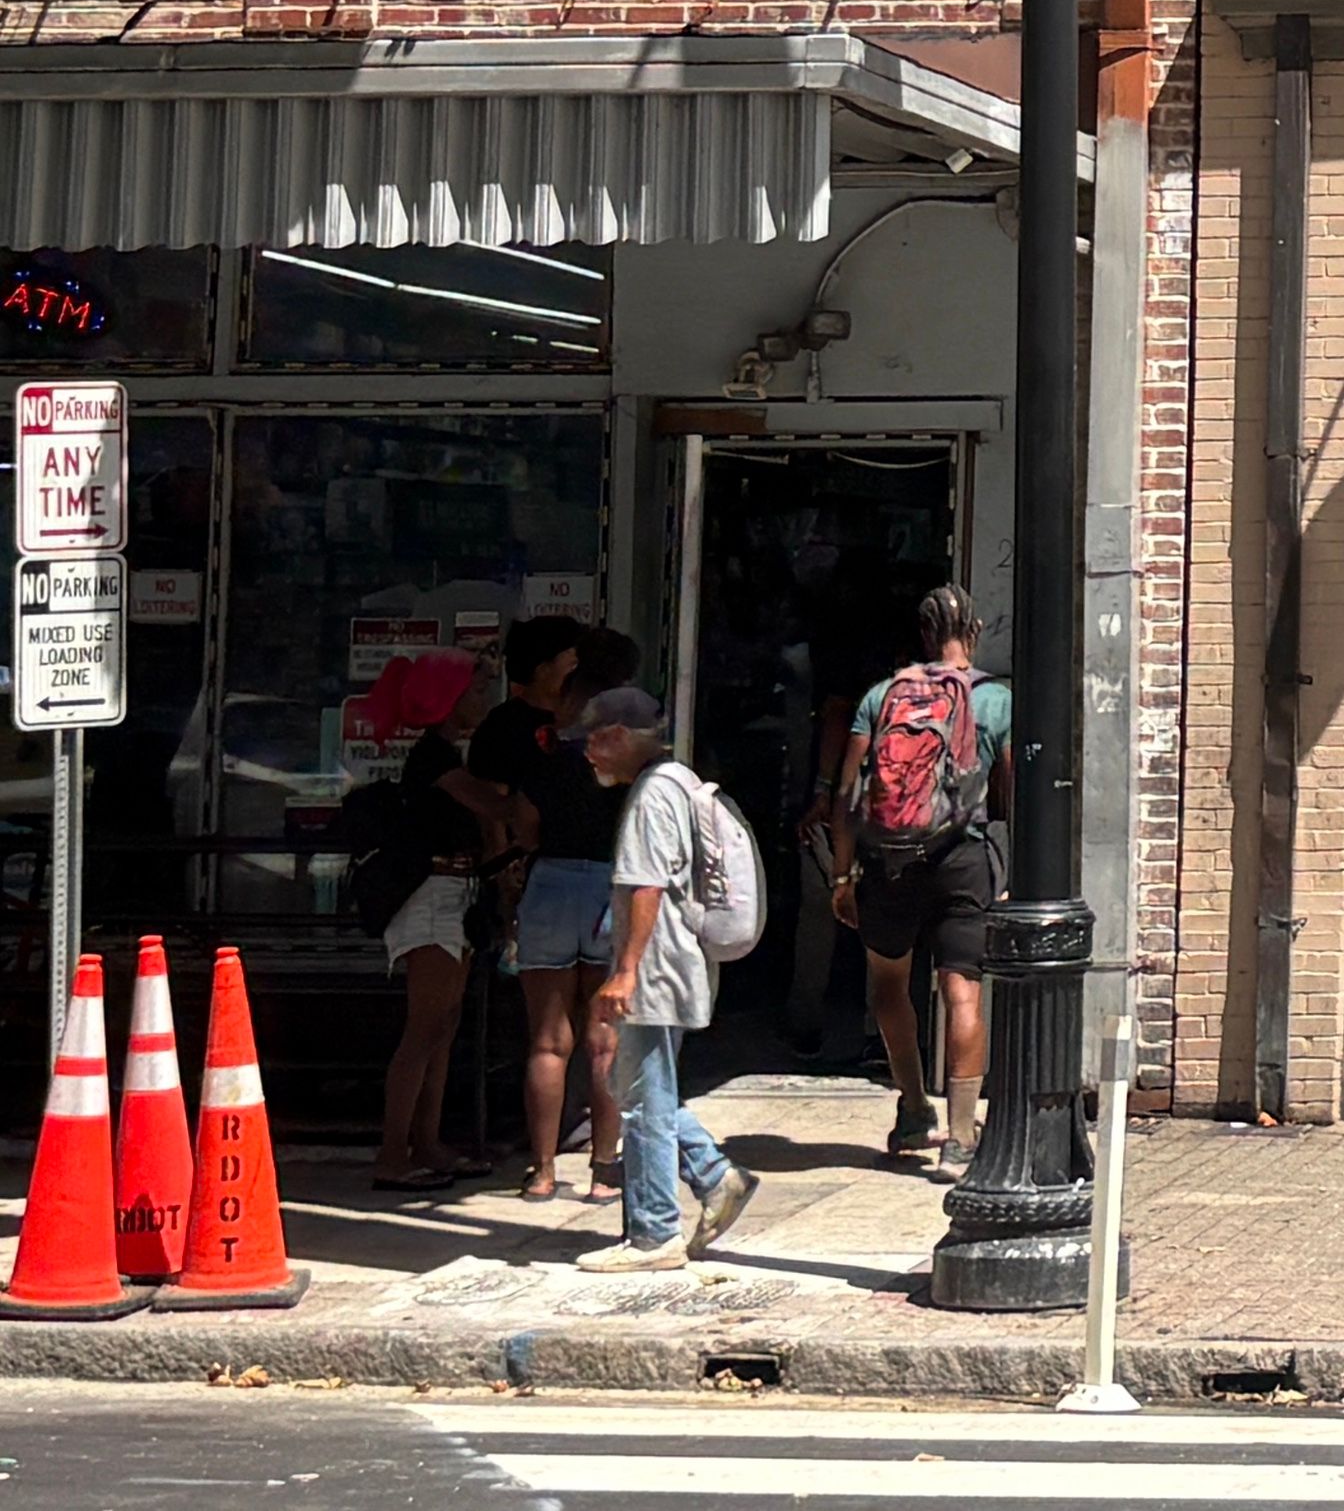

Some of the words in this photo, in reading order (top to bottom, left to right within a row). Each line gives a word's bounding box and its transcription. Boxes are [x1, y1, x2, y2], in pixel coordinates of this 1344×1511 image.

[4, 282, 91, 329] ATM
[22, 395, 51, 427] NO
[55, 399, 119, 421] PARKING
[42, 445, 102, 477] ANY
[39, 485, 106, 518] TIME
[21, 572, 49, 605] NO
[53, 575, 118, 598] PARKING
[28, 625, 75, 644] MIXED
[83, 623, 114, 642] USE
[39, 646, 104, 666] LOADING
[50, 668, 91, 687] ZONE
[219, 1113, 241, 1263] RDOT
